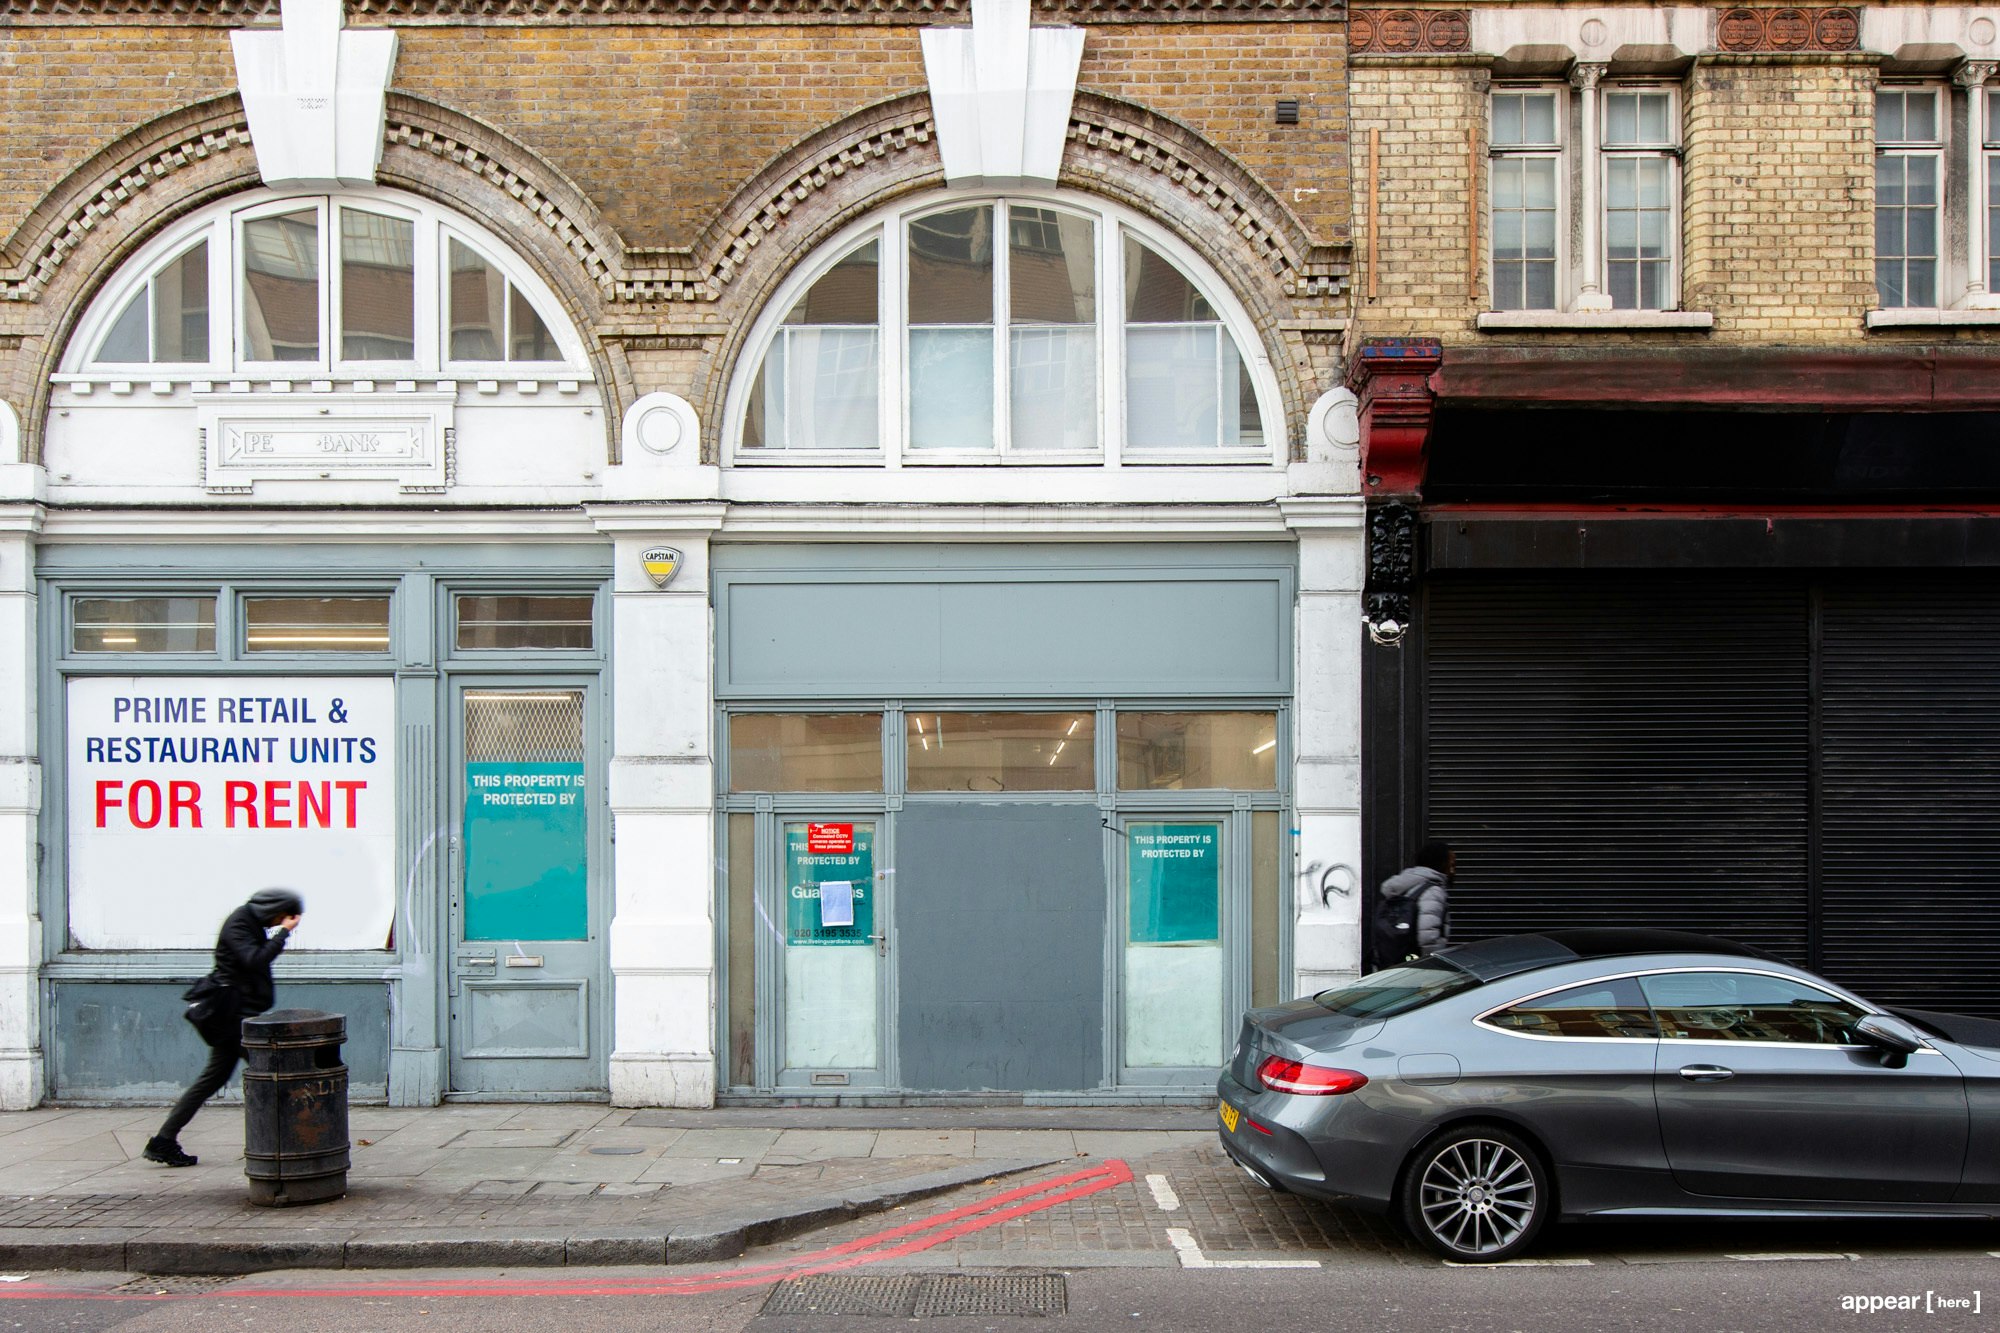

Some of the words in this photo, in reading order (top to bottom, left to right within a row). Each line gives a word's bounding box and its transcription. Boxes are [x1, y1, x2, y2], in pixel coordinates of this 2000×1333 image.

[646, 552, 674, 560] CAPSTAN
[114, 697, 206, 723] PRIME
[218, 697, 317, 723] RETAIL
[328, 698, 348, 723] &
[86, 737, 279, 763] RESTAURANT
[290, 737, 376, 763] UNITS
[473, 775, 501, 787] THIS
[504, 775, 570, 787] PROPERTY
[573, 775, 585, 787] IS
[484, 793, 556, 805] PROTECTED
[559, 793, 576, 805] BY
[96, 780, 203, 829] FOR
[225, 780, 367, 829] RENT
[1135, 835, 1154, 844] THIS
[1156, 835, 1201, 844] PROPERTY
[1203, 835, 1212, 844] IS
[790, 842, 808, 851] THIS
[858, 842, 867, 851] IS
[1141, 849, 1191, 858] PROTECTED
[1193, 849, 1205, 858] BY
[797, 857, 847, 865] PROTECTED
[848, 857, 860, 865] BY
[795, 929, 811, 938] 020
[814, 929, 837, 938] 3195
[839, 929, 862, 938] 3535
